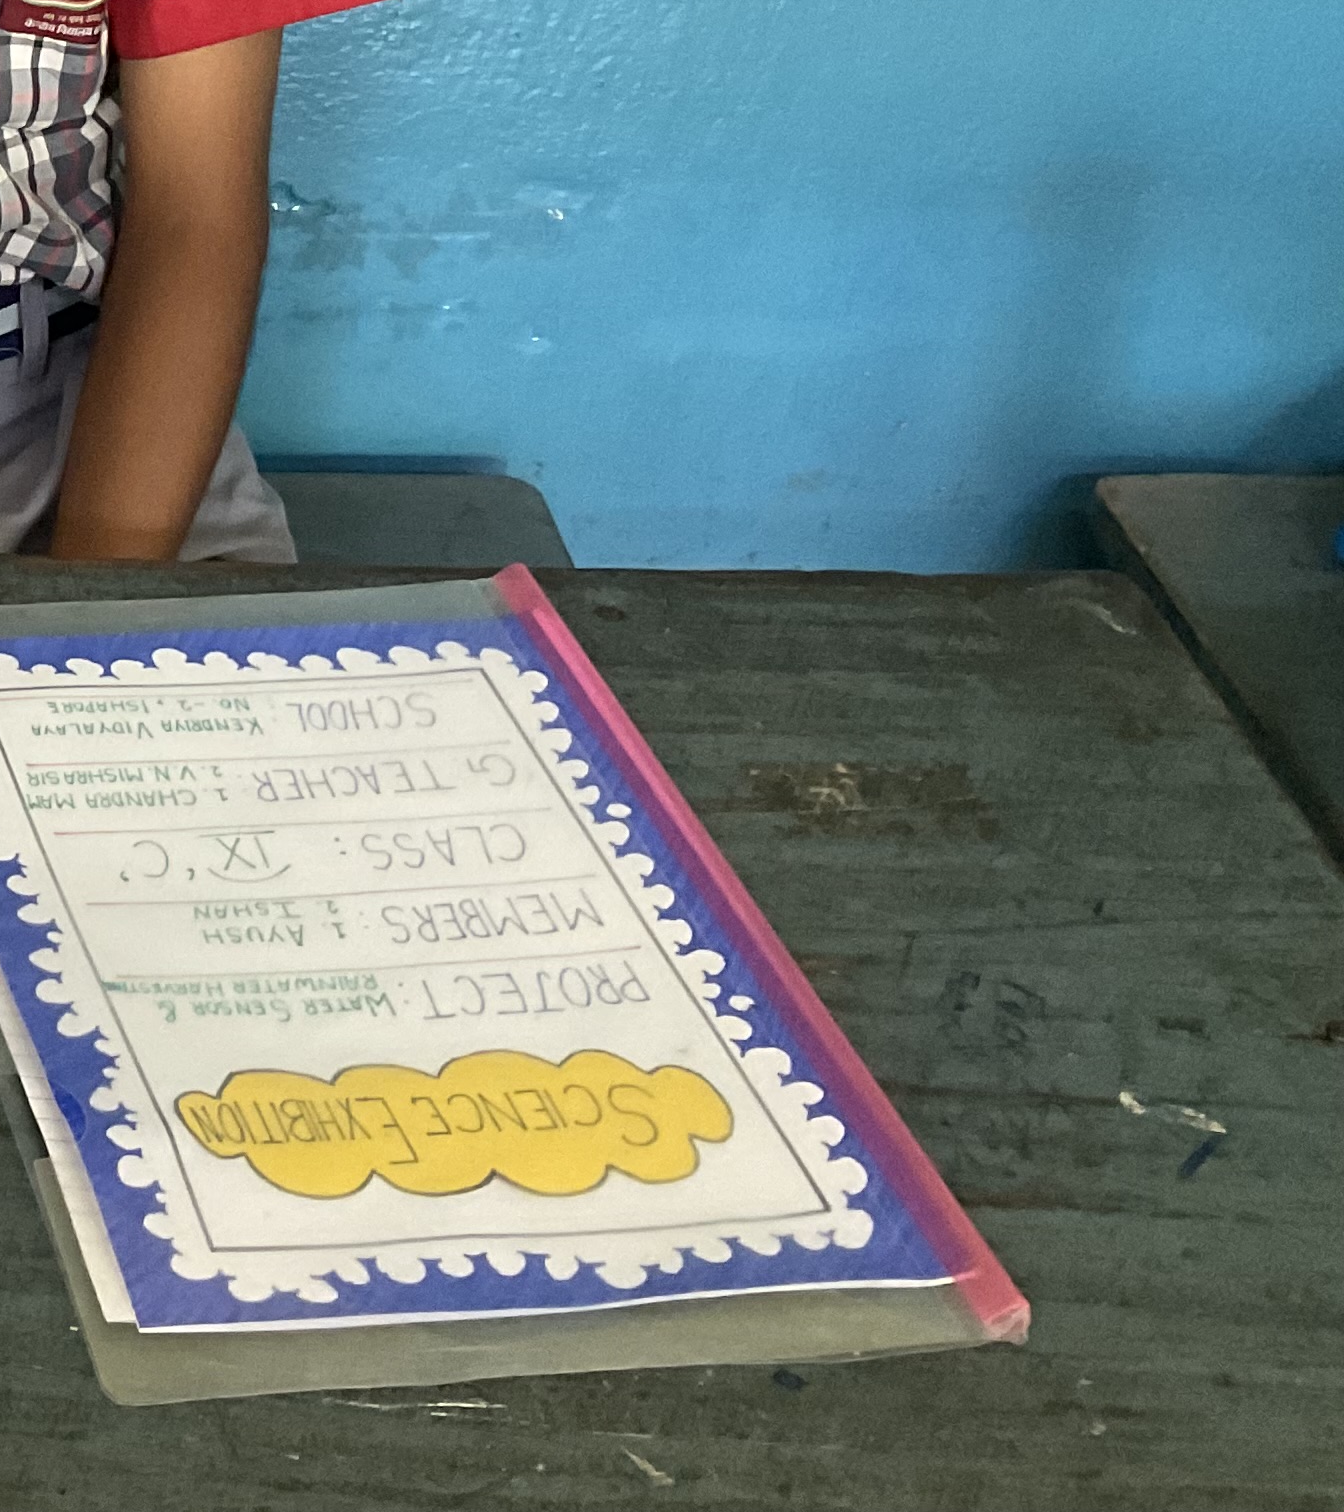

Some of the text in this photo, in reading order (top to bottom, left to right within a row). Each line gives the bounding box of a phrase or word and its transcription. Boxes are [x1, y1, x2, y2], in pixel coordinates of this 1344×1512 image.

[31, 718, 154, 740] VIDYALAYA
[161, 716, 264, 736] KENDRIYA
[86, 789, 198, 809] CHANDRA
[193, 899, 302, 919] ISHAN
[204, 923, 305, 947] AYUSH
[304, 993, 398, 1017] WATER
[190, 1084, 660, 1165] SCIENCE EXHIBITION
